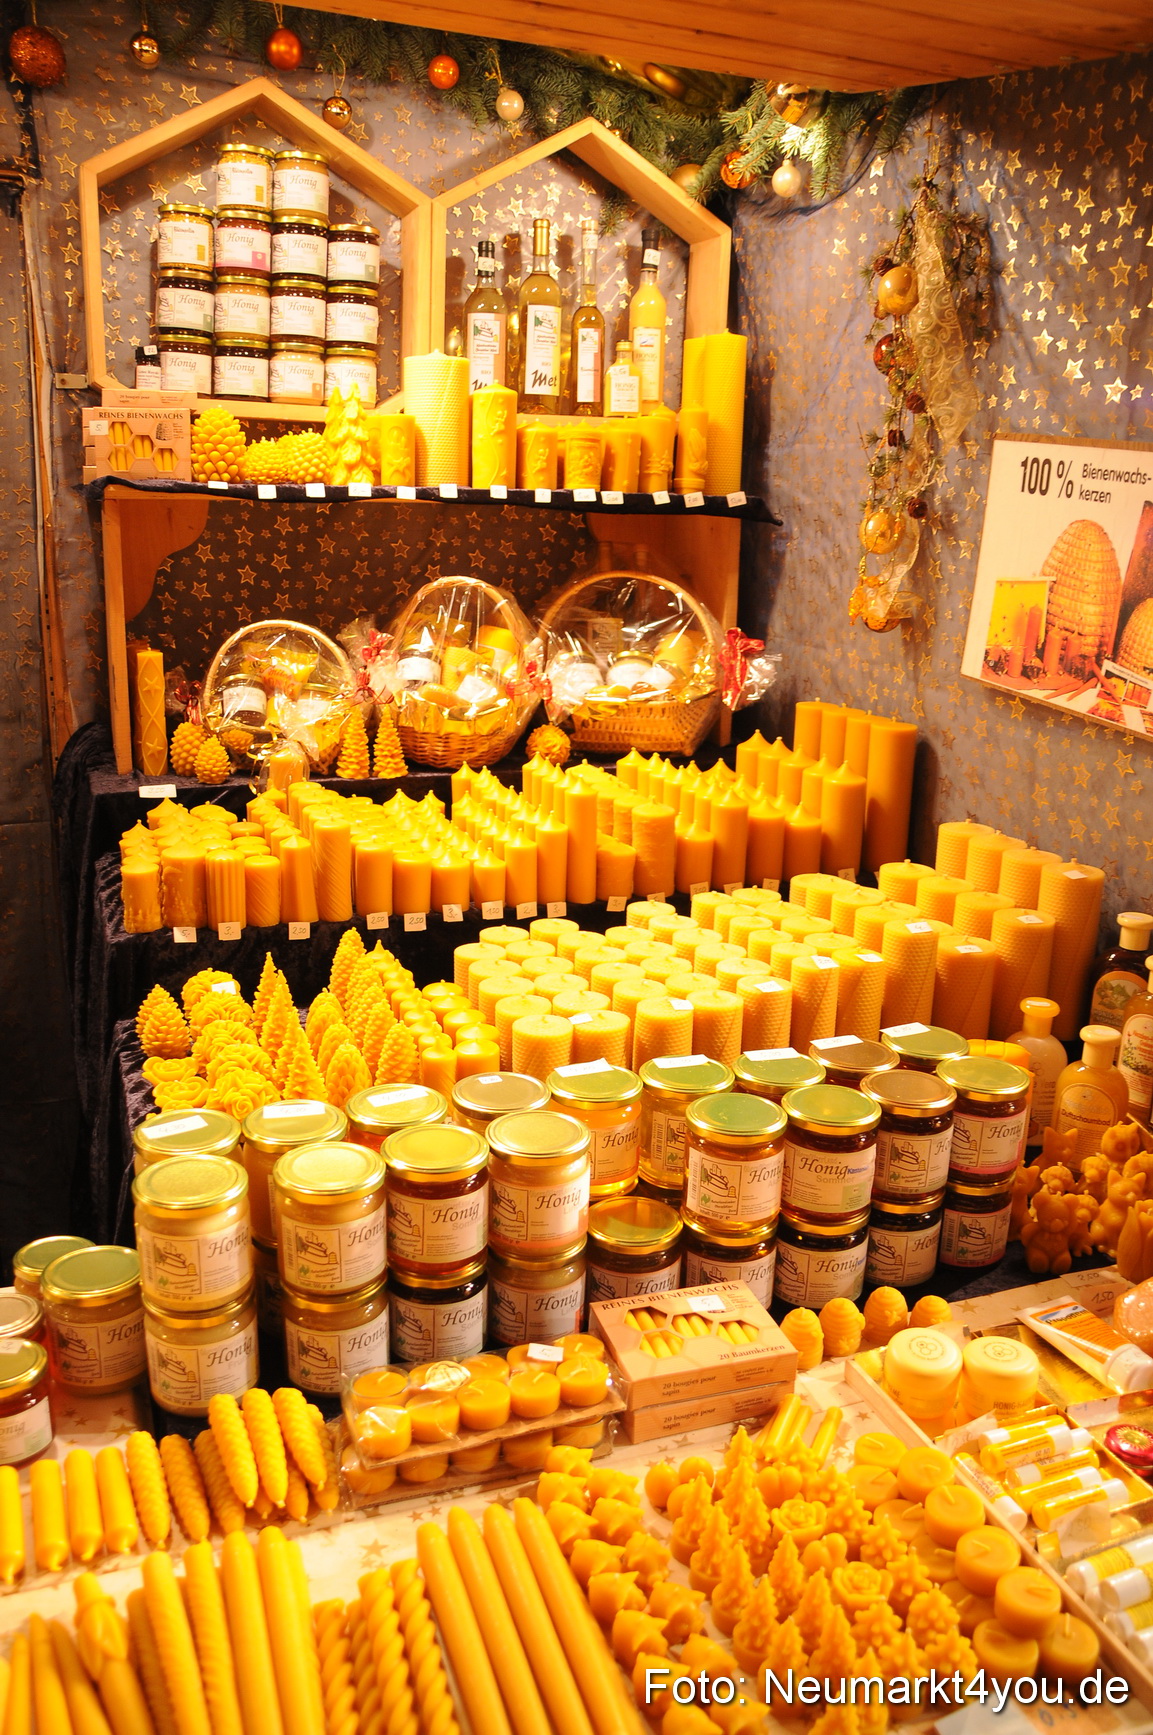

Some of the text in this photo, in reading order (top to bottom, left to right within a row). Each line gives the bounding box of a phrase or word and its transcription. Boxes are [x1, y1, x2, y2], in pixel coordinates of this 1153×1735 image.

[289, 174, 318, 189] Honig
[227, 232, 255, 246] Honig
[292, 239, 319, 253] Honig
[339, 247, 367, 261] Honig
[178, 294, 206, 308] Honig
[231, 299, 260, 313] Honig
[288, 302, 315, 315] Honig
[340, 308, 367, 322] Honig
[169, 357, 197, 371] Honig
[228, 362, 256, 375] Honig
[288, 365, 315, 379] Honig
[344, 369, 371, 382] Honig
[531, 369, 558, 389] Met
[98, 411, 184, 420] REINES BIENENWACHS
[1020, 456, 1074, 499] 100 %
[1081, 463, 1152, 486] Bienenwachs-
[1078, 484, 1112, 504] kerzen
[799, 1156, 849, 1180] Honig
[535, 1188, 582, 1210] Honig
[431, 1201, 480, 1224] Honig
[815, 1255, 858, 1274] Honig
[635, 1273, 676, 1295] Honig
[533, 1289, 579, 1312] Honig
[601, 1296, 645, 1311] REINES
[648, 1283, 740, 1302] BIENENWACHS
[206, 1335, 253, 1367] Honig
[718, 1344, 786, 1361] 20 Baumkerzen
[662, 1375, 717, 1390] 20 bougies pour
[661, 1388, 681, 1397] sapin
[663, 1406, 717, 1424] 20 bougies pour
[0, 1418, 26, 1436] onig
[662, 1421, 681, 1431] sapin
